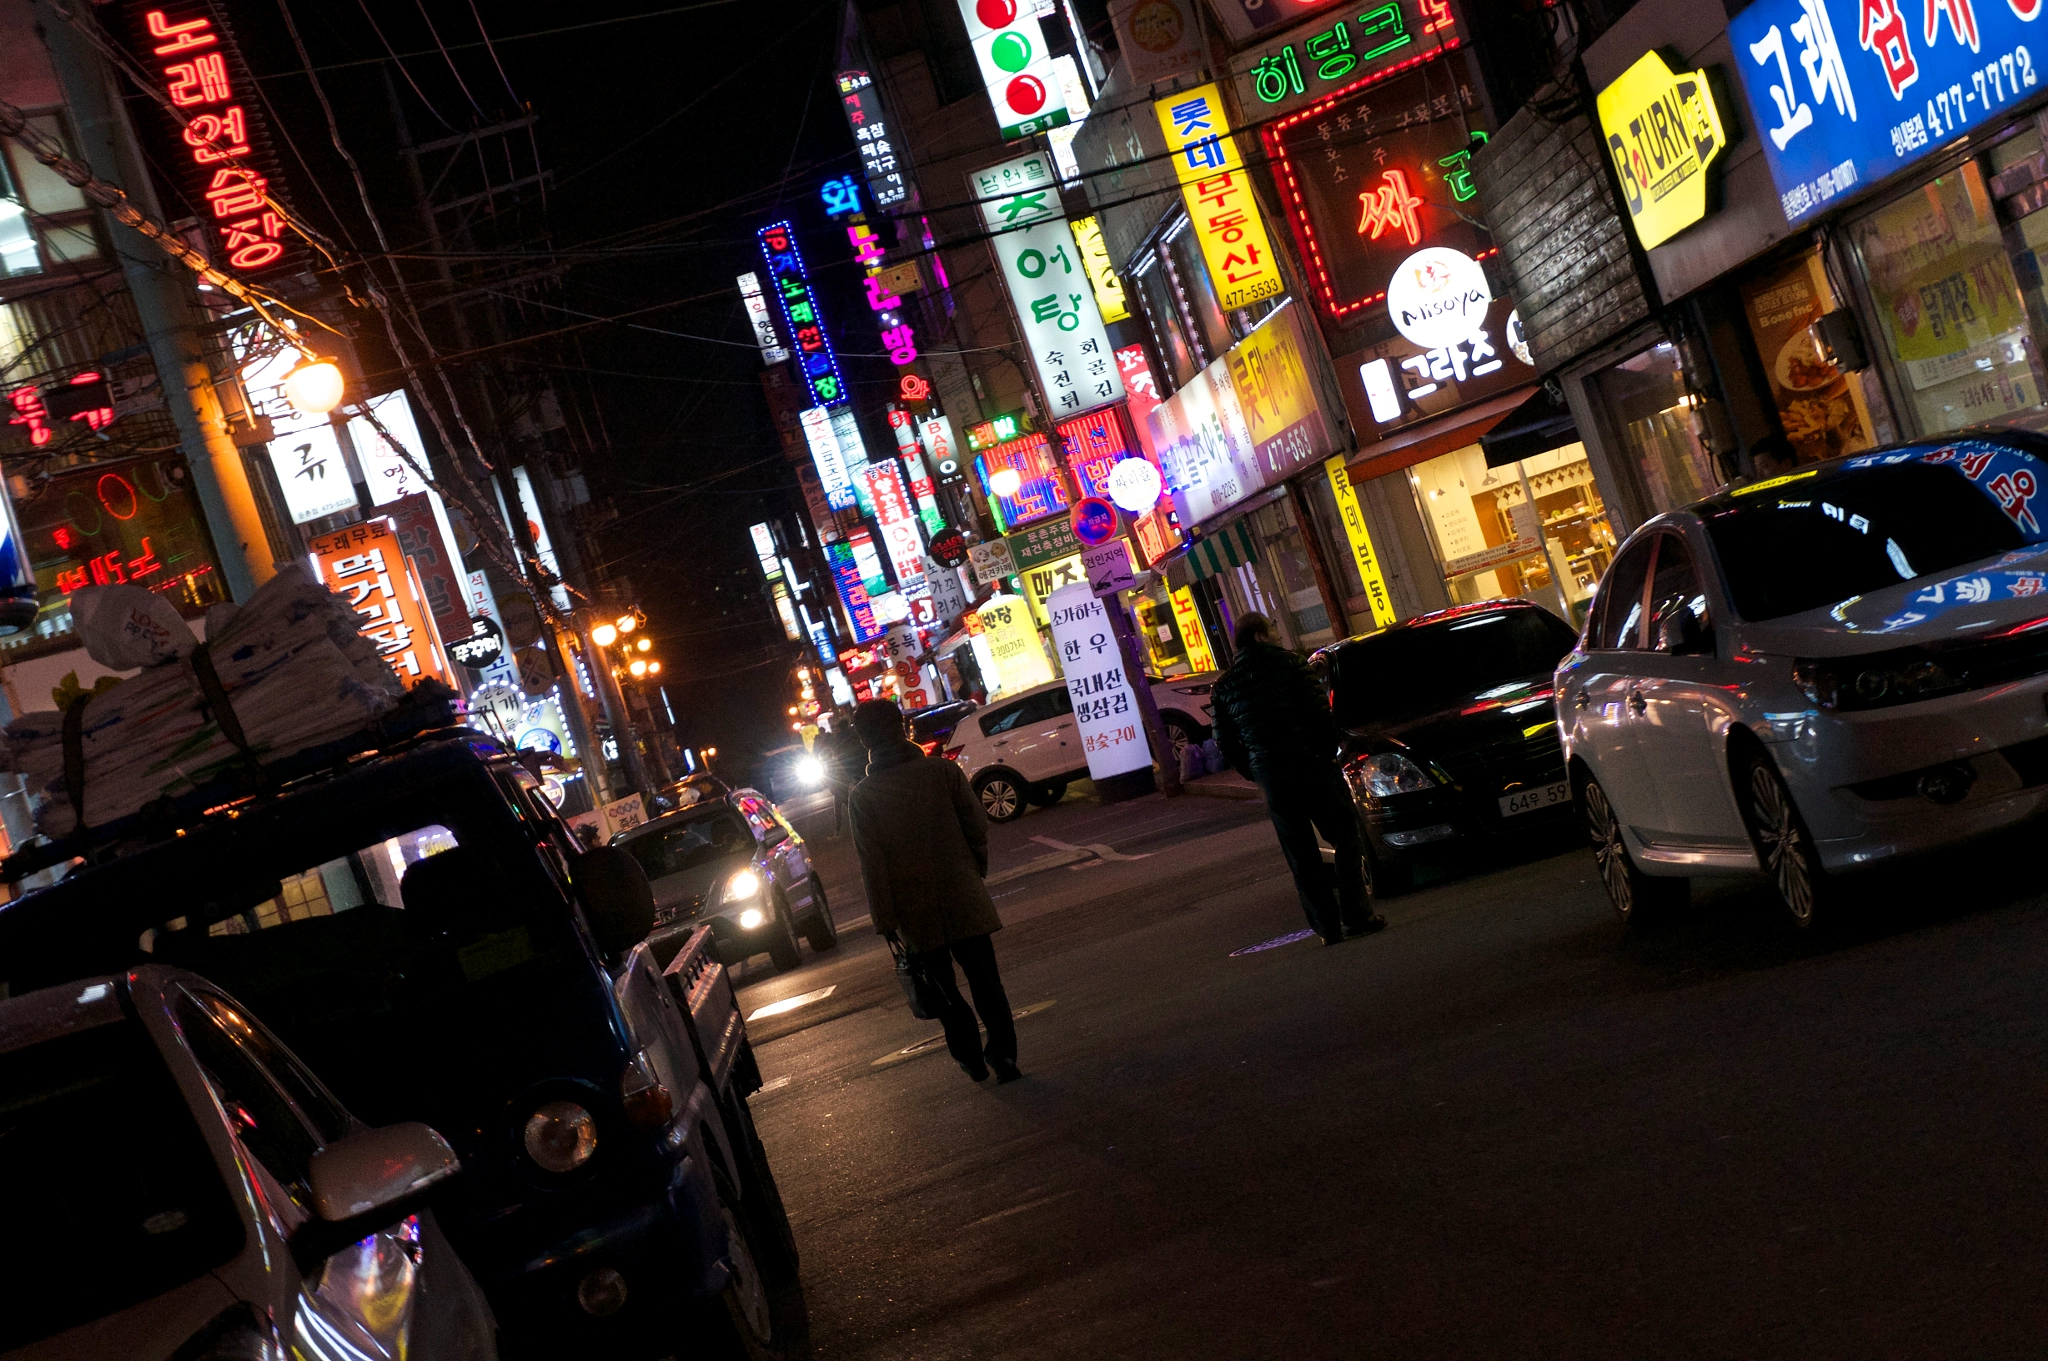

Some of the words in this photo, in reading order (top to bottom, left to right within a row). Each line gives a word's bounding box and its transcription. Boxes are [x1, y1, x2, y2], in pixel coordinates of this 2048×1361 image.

[1250, 1, 1411, 103] 히딩크
[1749, 0, 1857, 151] 고래
[1926, 44, 2038, 139] 477-7772
[845, 94, 865, 125] 제주
[147, 12, 284, 269] 노래연습장
[997, 191, 1083, 332] 추어탕
[1225, 278, 1279, 309] 477-5533
[312, 521, 389, 557] 노래무료
[978, 563, 1014, 581] 애견카페
[1084, 548, 1126, 571] 견인지역
[1052, 601, 1104, 627] 소가하누
[1070, 667, 1122, 698] 국내산
[1076, 691, 1129, 723] 생삼겹
[1085, 724, 1137, 752] 참숯구이
[1509, 790, 1541, 813] 64우
